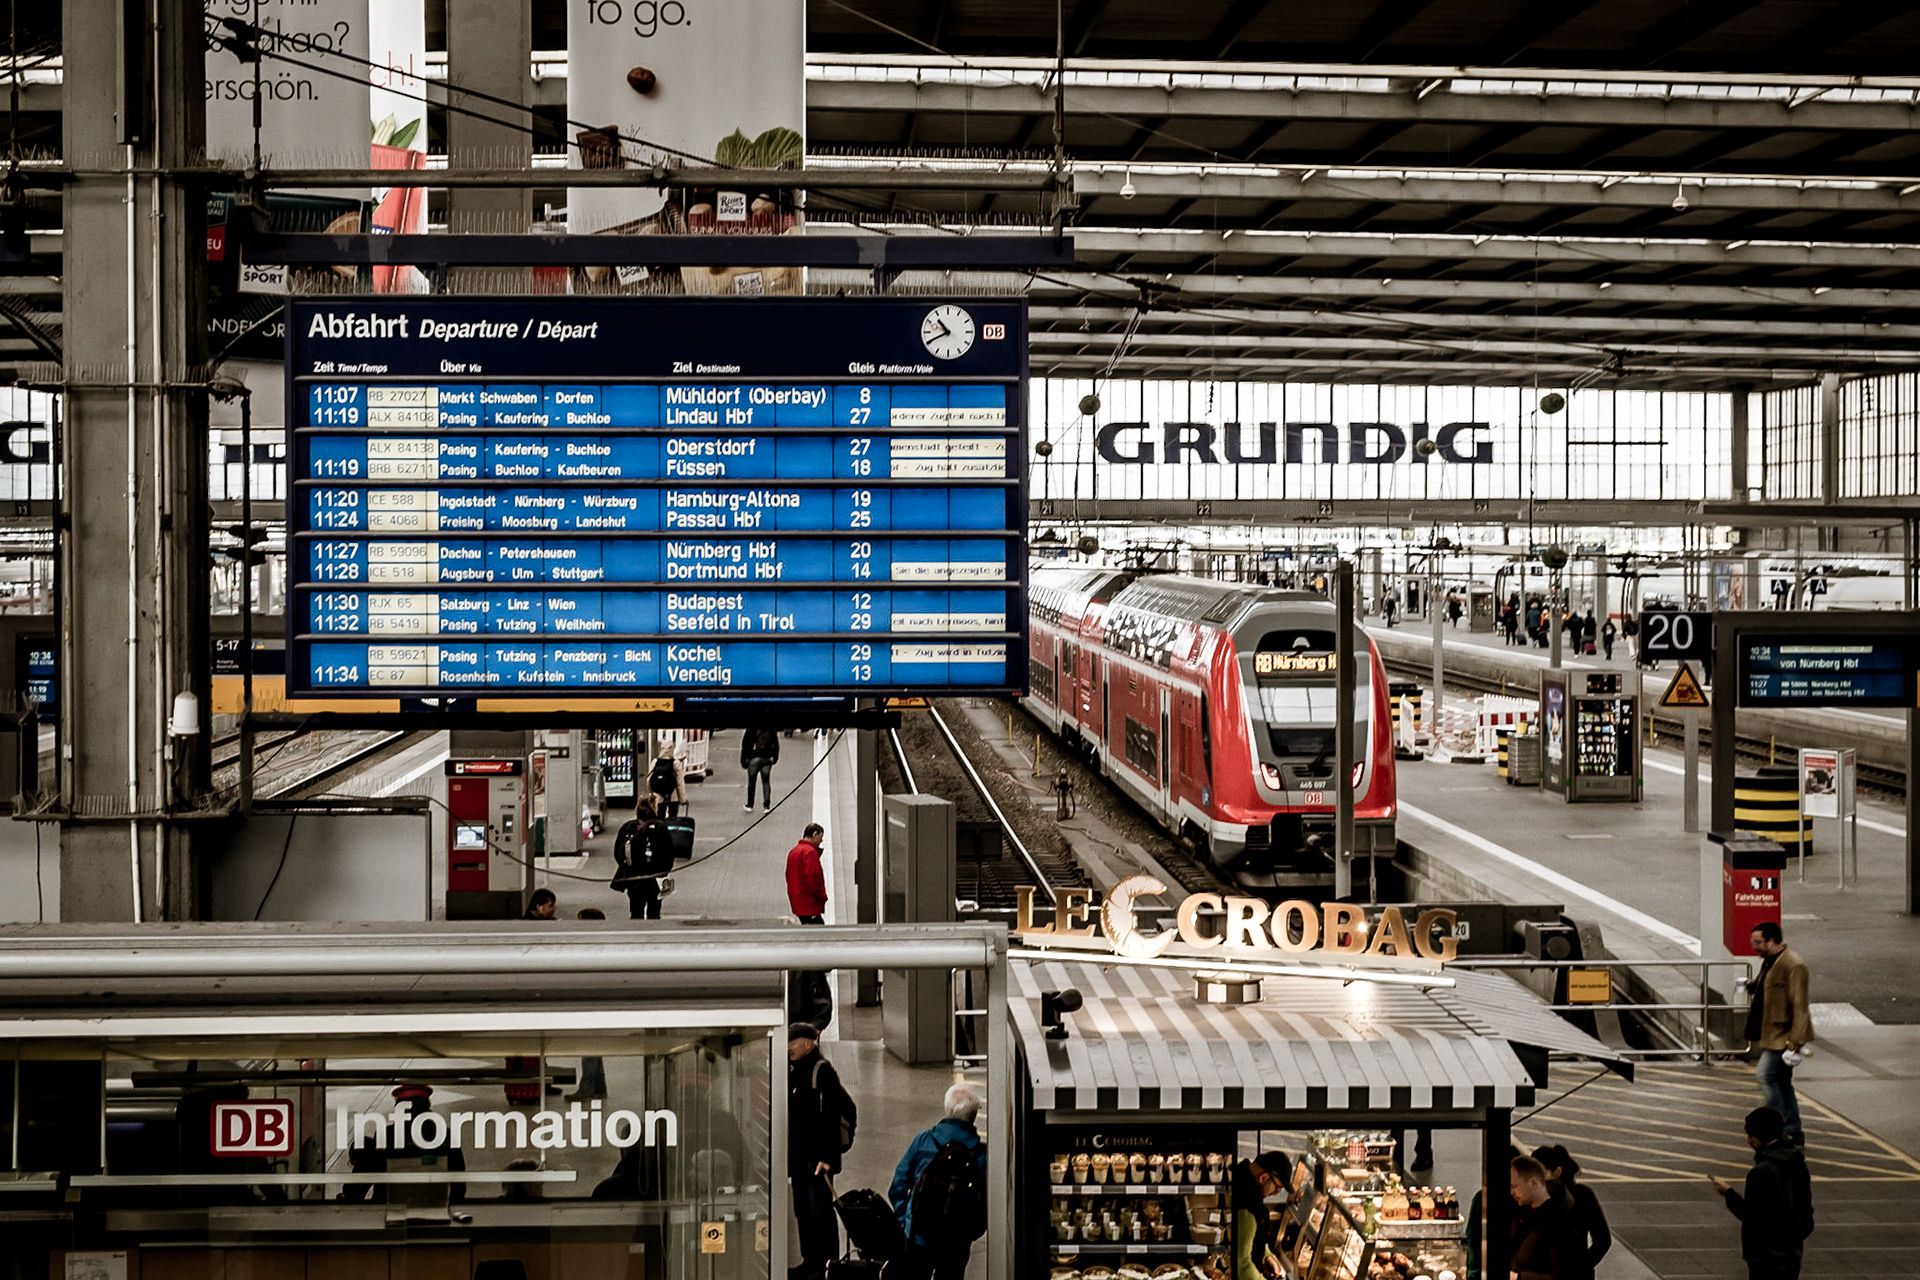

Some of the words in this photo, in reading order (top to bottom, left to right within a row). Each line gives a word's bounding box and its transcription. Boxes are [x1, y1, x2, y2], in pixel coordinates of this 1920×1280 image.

[588, 0, 622, 25] to
[634, 1, 691, 38] go.
[243, 271, 283, 284] SPORT
[308, 313, 409, 339] Abfahrt
[419, 319, 518, 342] Departure
[537, 319, 598, 342] Départ
[986, 327, 1002, 337] DB
[313, 361, 334, 373] Zeit
[337, 363, 388, 375] Time/Temps
[440, 360, 466, 374] Über
[469, 363, 482, 373] Via
[672, 362, 693, 373] Ziel
[696, 363, 740, 374] Destination
[848, 362, 875, 374] Gleis
[879, 363, 934, 375] Platform/Voie
[314, 387, 358, 403] 11:07
[369, 391, 383, 401] RB
[390, 391, 426, 401] 27027
[440, 392, 474, 403] Markt
[480, 392, 537, 403] Schwaben
[556, 392, 593, 403] Dorfen
[667, 388, 740, 403] Mühldorf
[749, 388, 826, 407] (Oberbay)
[860, 388, 870, 403] 8
[314, 408, 358, 424] 11:19
[370, 412, 391, 422] ALX
[397, 412, 434, 422] 84108
[440, 412, 476, 427] Pasing
[496, 412, 548, 427] Kaufering
[567, 412, 610, 424] Buchloe
[667, 408, 717, 424] Lindau
[726, 408, 753, 424] Hbf
[850, 408, 870, 424] 27
[370, 443, 391, 452] ALX
[397, 443, 434, 452] 84138
[440, 444, 476, 458] Pasing
[495, 444, 548, 458] Kaufering
[567, 444, 610, 455] Buchloe
[667, 439, 755, 455] Oberstdorf
[850, 439, 870, 455] 27
[1097, 422, 1493, 464] GRUNDIG
[314, 459, 358, 475] 11:19
[370, 464, 391, 474] BRB
[396, 464, 432, 474] 62711
[440, 464, 476, 478] Pasing
[496, 464, 539, 475] Buchloe
[558, 464, 621, 475] Kaufbeuren
[667, 459, 725, 475] Füssen
[851, 459, 871, 475] 18
[17, 505, 28, 515] 13
[314, 491, 358, 507] 11:20
[368, 494, 386, 504] ICE
[392, 494, 414, 504] 588
[440, 496, 496, 510] Ingolstadt
[515, 496, 564, 510] Nürnberg
[584, 496, 636, 510] Würzburg
[667, 491, 800, 511] Hamburg-Altona
[852, 491, 871, 507] 19
[1198, 505, 1210, 515] 22
[1320, 504, 1331, 515] 23
[314, 511, 358, 527] 11:24
[370, 515, 382, 525] RE
[390, 515, 418, 525] 4068
[440, 516, 483, 530] Freising
[502, 516, 557, 530] Moosburg
[576, 516, 626, 527] Landshut
[667, 511, 726, 527] Passau
[734, 511, 761, 527] Hbf
[851, 511, 871, 527] 25
[315, 543, 358, 559] 11:27
[370, 546, 384, 556] RB
[390, 546, 427, 556] 59096
[440, 547, 481, 558] Dachau
[500, 547, 576, 558] Petershausen
[667, 542, 741, 562] Nürnberg
[749, 542, 775, 558] Hbf
[851, 542, 871, 558] 20
[315, 563, 358, 579] 11:28
[369, 567, 387, 578] ICE
[392, 567, 414, 578] 518
[440, 568, 493, 582] Augsburg
[512, 568, 533, 579] Ulm
[552, 568, 604, 582] Stuttgart
[667, 562, 747, 578] Dortmund
[755, 562, 782, 578] Hbf
[852, 562, 871, 578] 14
[1773, 581, 1784, 592] A
[1815, 581, 1826, 592] A
[315, 594, 358, 610] 11:30
[370, 598, 391, 608] RJX
[397, 598, 412, 608] 65
[440, 599, 489, 613] Salzburg
[508, 599, 529, 610] Linz
[548, 599, 575, 610] Wien
[667, 594, 743, 614] Budapest
[852, 594, 871, 609] 12
[315, 615, 358, 630] 11:32
[370, 618, 384, 628] RB
[390, 618, 420, 628] 5419
[440, 619, 477, 633] Pasing
[496, 619, 536, 633] Tutzing
[555, 619, 604, 630] Weilheim
[668, 614, 729, 630] Seefeld
[738, 614, 751, 630] in
[759, 614, 794, 630] Tirol
[851, 614, 871, 629] 29
[1647, 613, 1693, 651] 20
[216, 639, 240, 651] 5-17
[370, 650, 384, 660] RB
[390, 650, 426, 660] 59621
[440, 650, 477, 664] Pasing
[496, 650, 536, 664] Tutzing
[555, 650, 606, 664] Penzberg
[625, 650, 651, 662] Bichl
[668, 645, 721, 661] Kochel
[851, 645, 871, 661] 29
[1256, 654, 1273, 673] RB
[1273, 654, 1326, 671] Nürnberg
[1780, 660, 1796, 668] von
[1800, 658, 1840, 670] Nürnberg
[1843, 658, 1859, 668] Hbf
[315, 666, 358, 682] 11:34
[370, 670, 384, 680] EC
[390, 670, 404, 680] 87
[440, 671, 499, 682] Rosenheim
[519, 671, 564, 682] Kufstein
[583, 671, 636, 682] Innsbruck
[668, 665, 731, 685] Venedig
[852, 665, 871, 681] 13
[1306, 793, 1321, 803] DB
[1735, 893, 1774, 901] Fahrkarten
[1014, 885, 1105, 937] LE
[1176, 893, 1458, 962] CROBAG
[1455, 924, 1468, 936] 20
[222, 1109, 284, 1147] DB
[336, 1099, 677, 1150] Information
[1105, 1137, 1152, 1146] CROBAG
